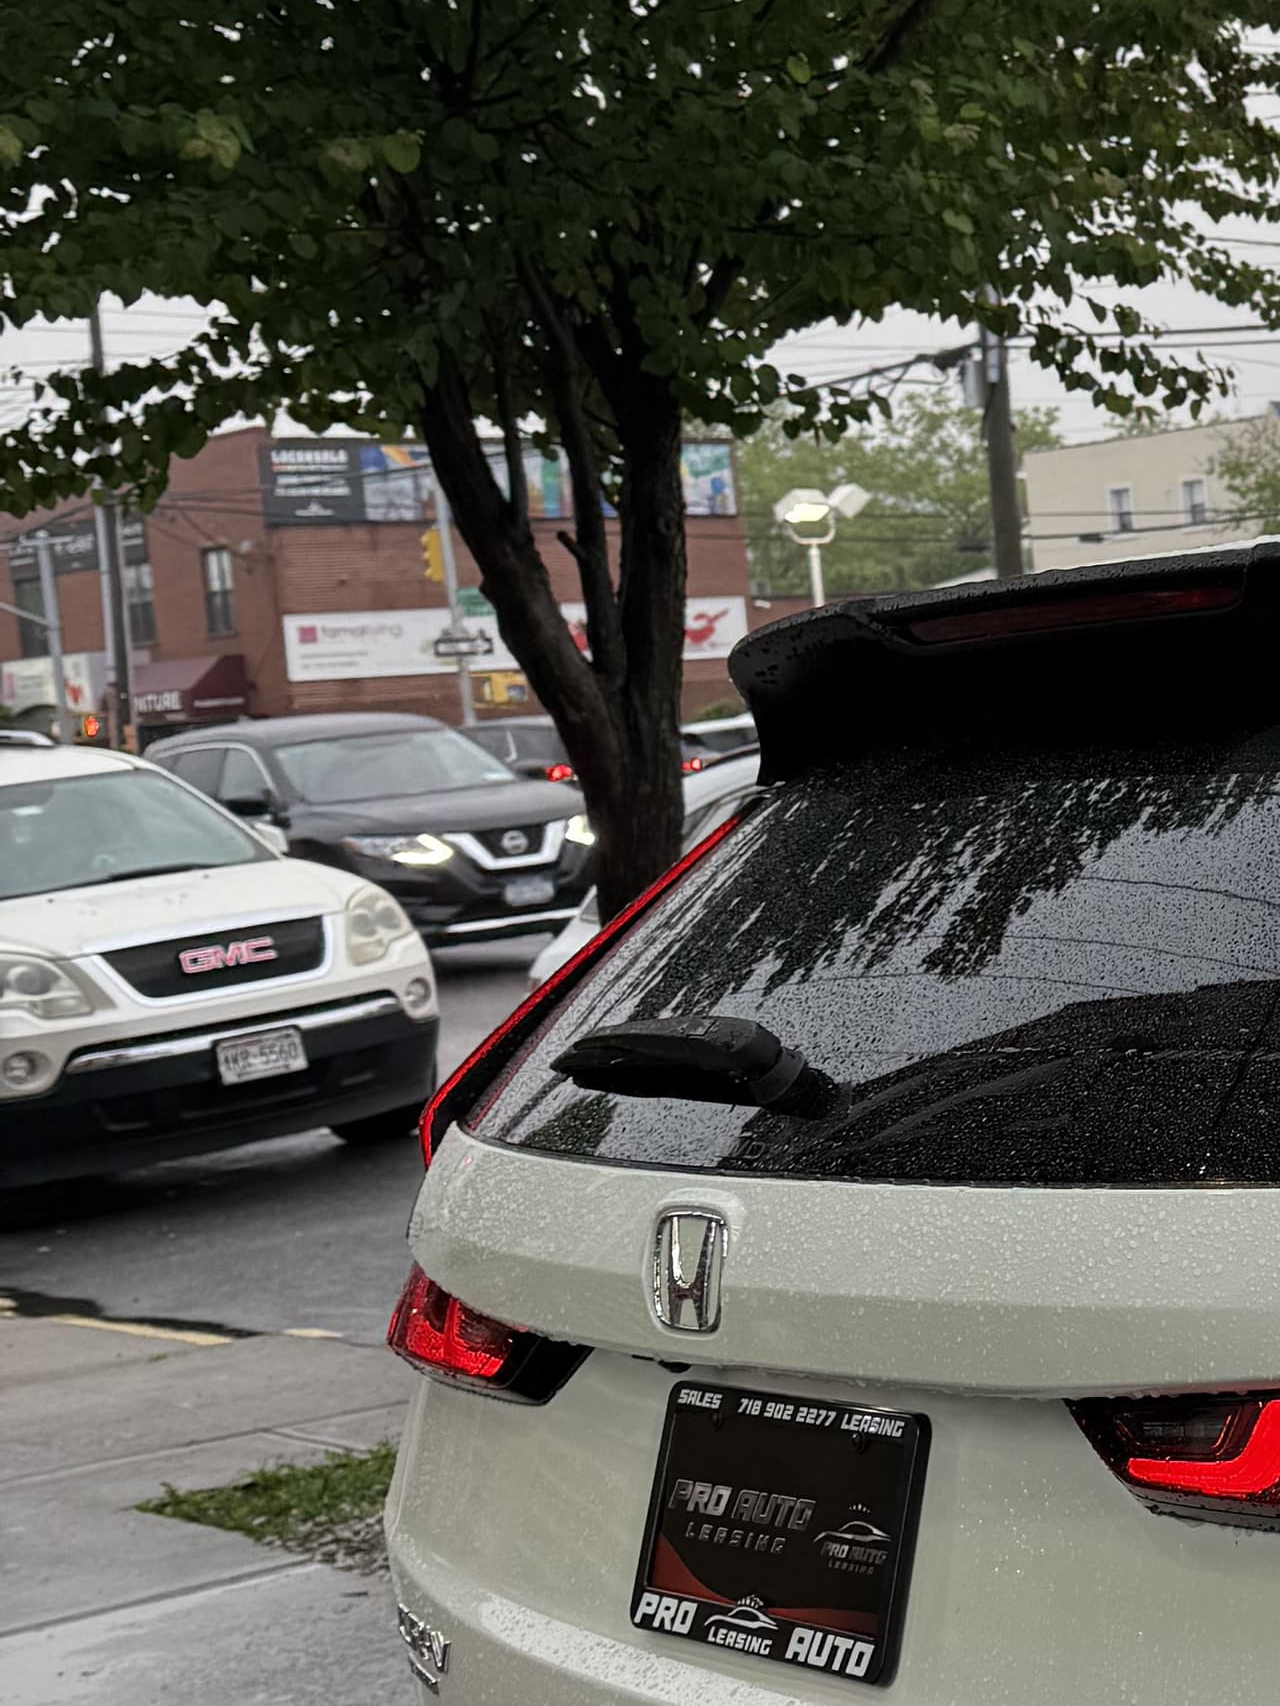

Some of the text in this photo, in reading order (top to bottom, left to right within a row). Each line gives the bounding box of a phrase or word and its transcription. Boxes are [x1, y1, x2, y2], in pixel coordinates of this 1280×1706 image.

[178, 935, 278, 974] GMC
[678, 1389, 905, 1438] SALES 718 902 2277 LEASING
[667, 1478, 816, 1531] PRO AUTO
[685, 1521, 787, 1555] LEASING
[819, 1541, 849, 1559] PRO
[633, 1591, 875, 1678] PRO LEASING AUTO
